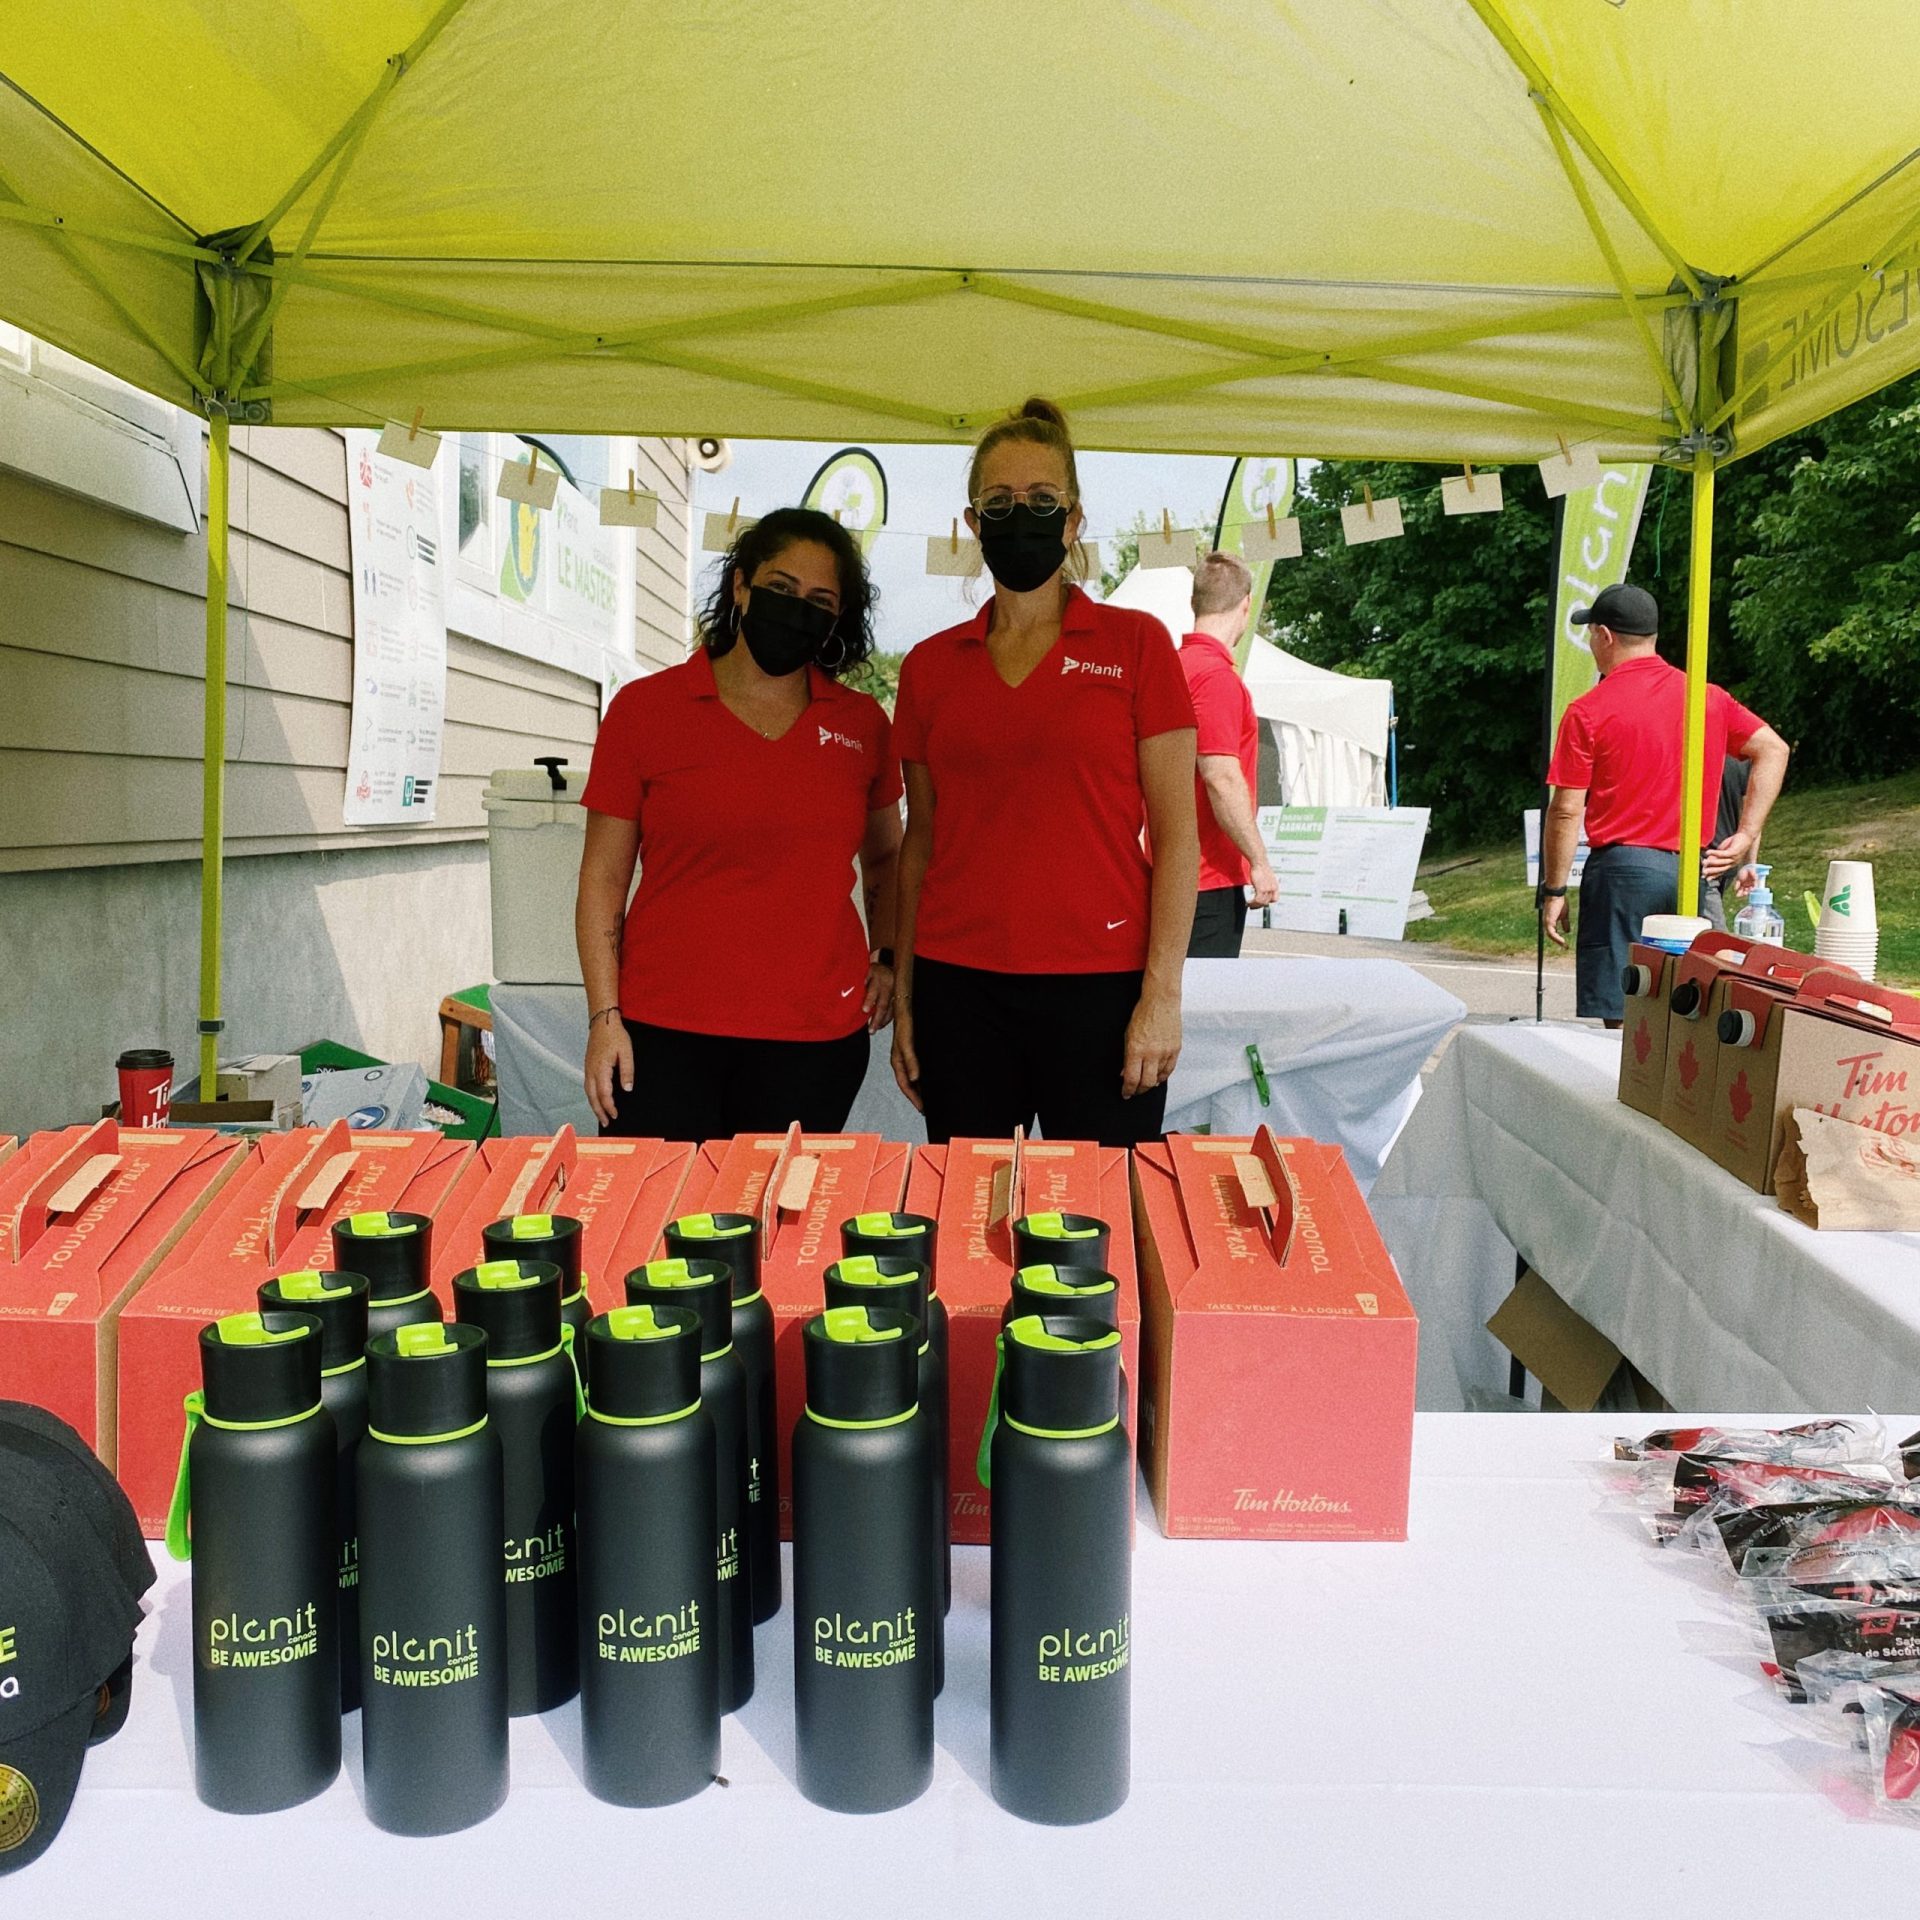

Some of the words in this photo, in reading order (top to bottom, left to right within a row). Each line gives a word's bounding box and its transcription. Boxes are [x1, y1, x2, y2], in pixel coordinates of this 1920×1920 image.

[1566, 470, 1627, 653] plan
[1081, 662, 1123, 679] Planit
[834, 732, 863, 753] Planit
[1836, 1052, 1908, 1099] Tim
[972, 1175, 991, 1220] ALWAYS
[43, 1195, 119, 1271] TOUJOURS
[797, 1198, 832, 1266] TOUJOURS
[157, 1305, 183, 1313] TAKE
[777, 1304, 813, 1312] DOUZE
[955, 1305, 995, 1313] TWELVE
[1236, 1304, 1273, 1312] TWELVE
[1361, 1300, 1376, 1309] 12
[1233, 1489, 1270, 1511] Tim
[1272, 1488, 1350, 1512] Hortons
[505, 1556, 565, 1583] WESOME
[211, 1602, 316, 1646] planit
[599, 1600, 699, 1639] planit
[815, 1607, 915, 1643] planit
[211, 1648, 229, 1666] BE
[232, 1638, 318, 1667] AWESOME
[373, 1624, 478, 1662] planit
[599, 1642, 617, 1660] BE
[620, 1635, 700, 1662] AWESOME
[815, 1646, 833, 1665] BE
[836, 1643, 916, 1668] AWESOME
[374, 1664, 390, 1684] BE
[392, 1660, 479, 1687] AWESOME
[1039, 1665, 1060, 1682] BE
[1063, 1648, 1129, 1682] AWESOME
